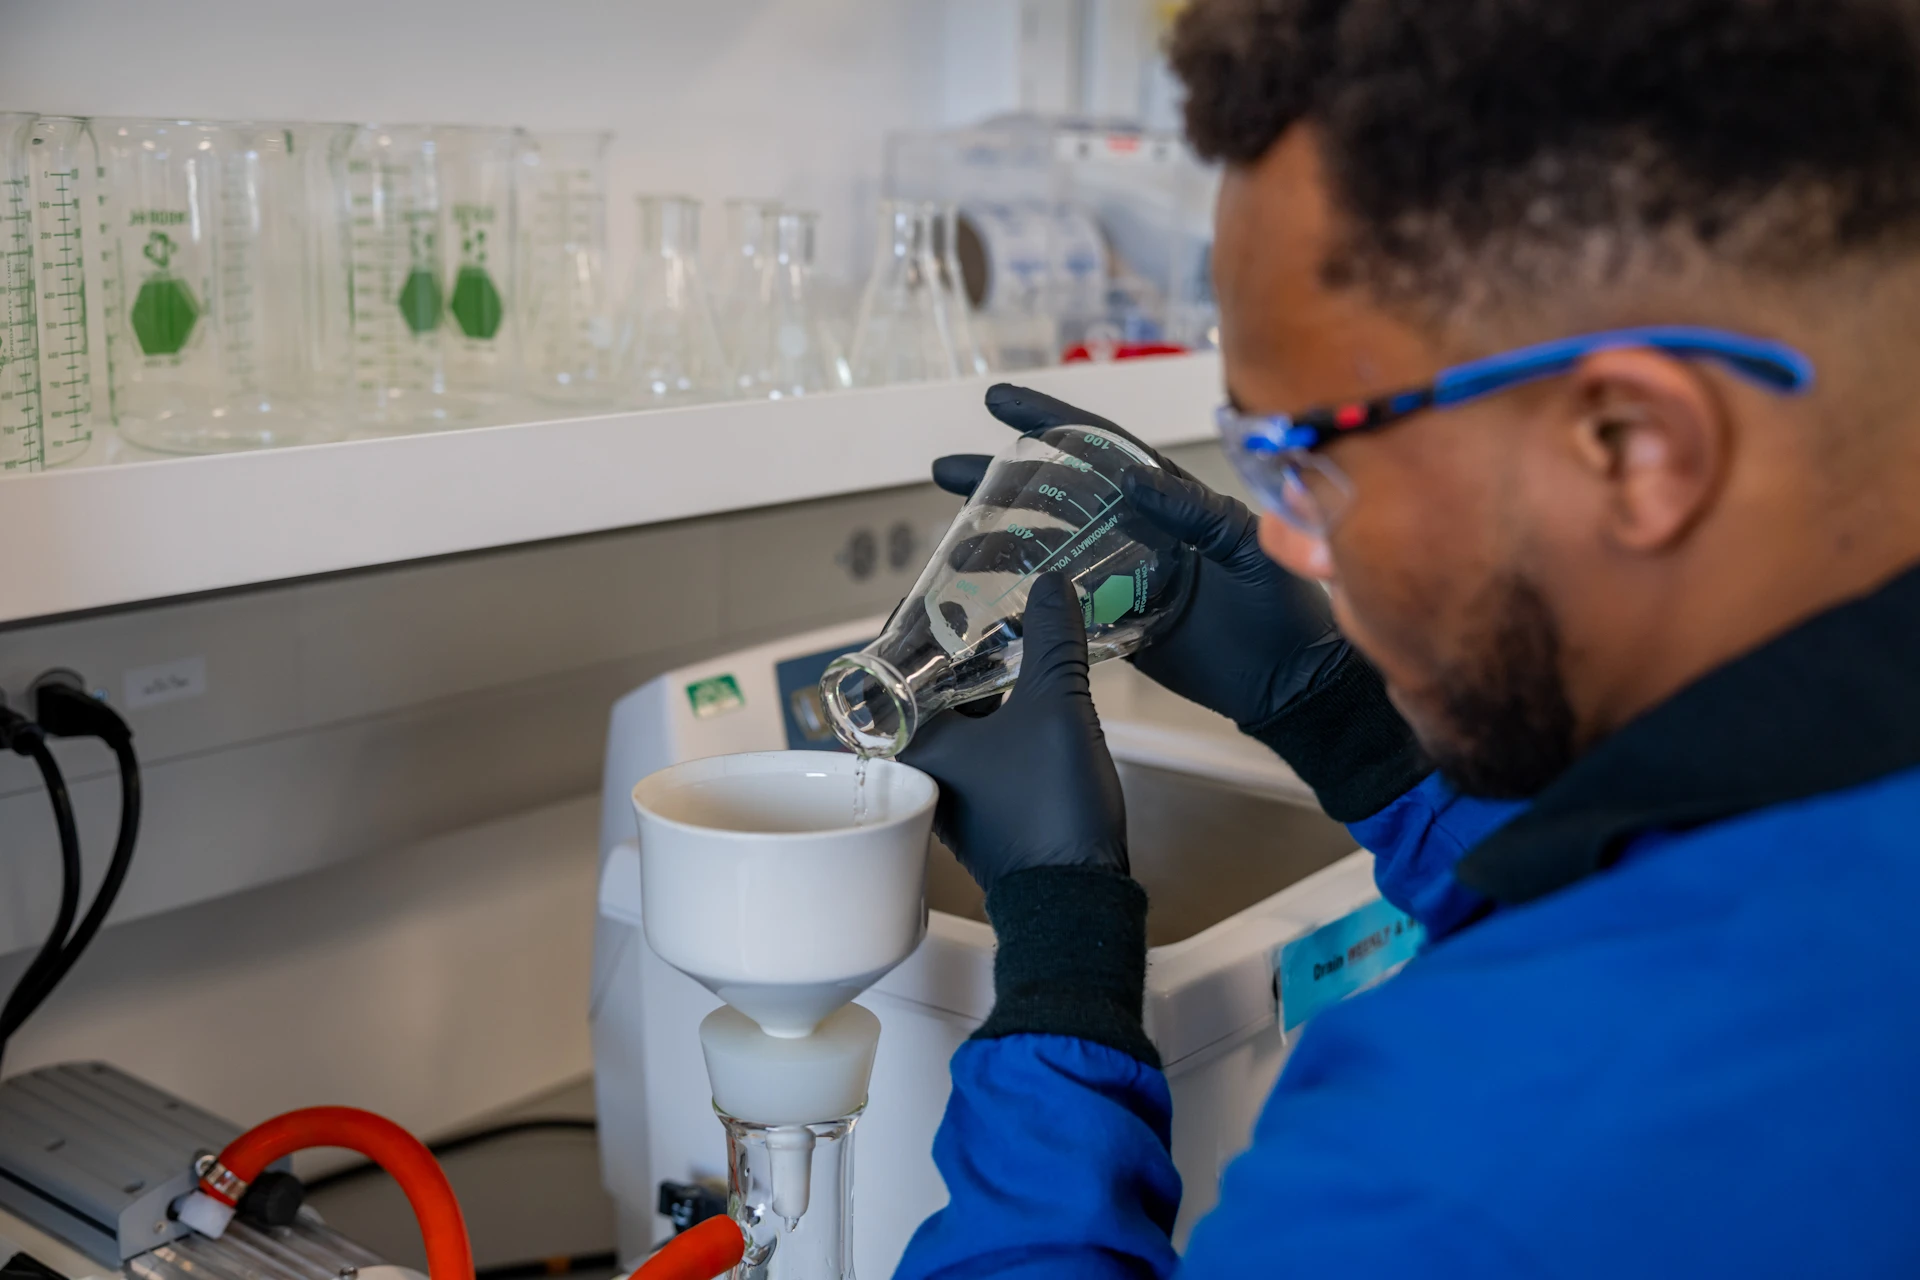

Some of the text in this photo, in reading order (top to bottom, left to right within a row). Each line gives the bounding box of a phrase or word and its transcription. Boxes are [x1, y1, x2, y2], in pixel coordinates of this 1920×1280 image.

[1084, 434, 1110, 450] 100
[1064, 455, 1093, 473] 200
[1038, 484, 1067, 501] 300
[1007, 523, 1034, 540] 400
[1047, 514, 1118, 571] APPROXIMATE VOLU
[956, 579, 979, 597] 500
[1138, 578, 1148, 614] STOPPER
